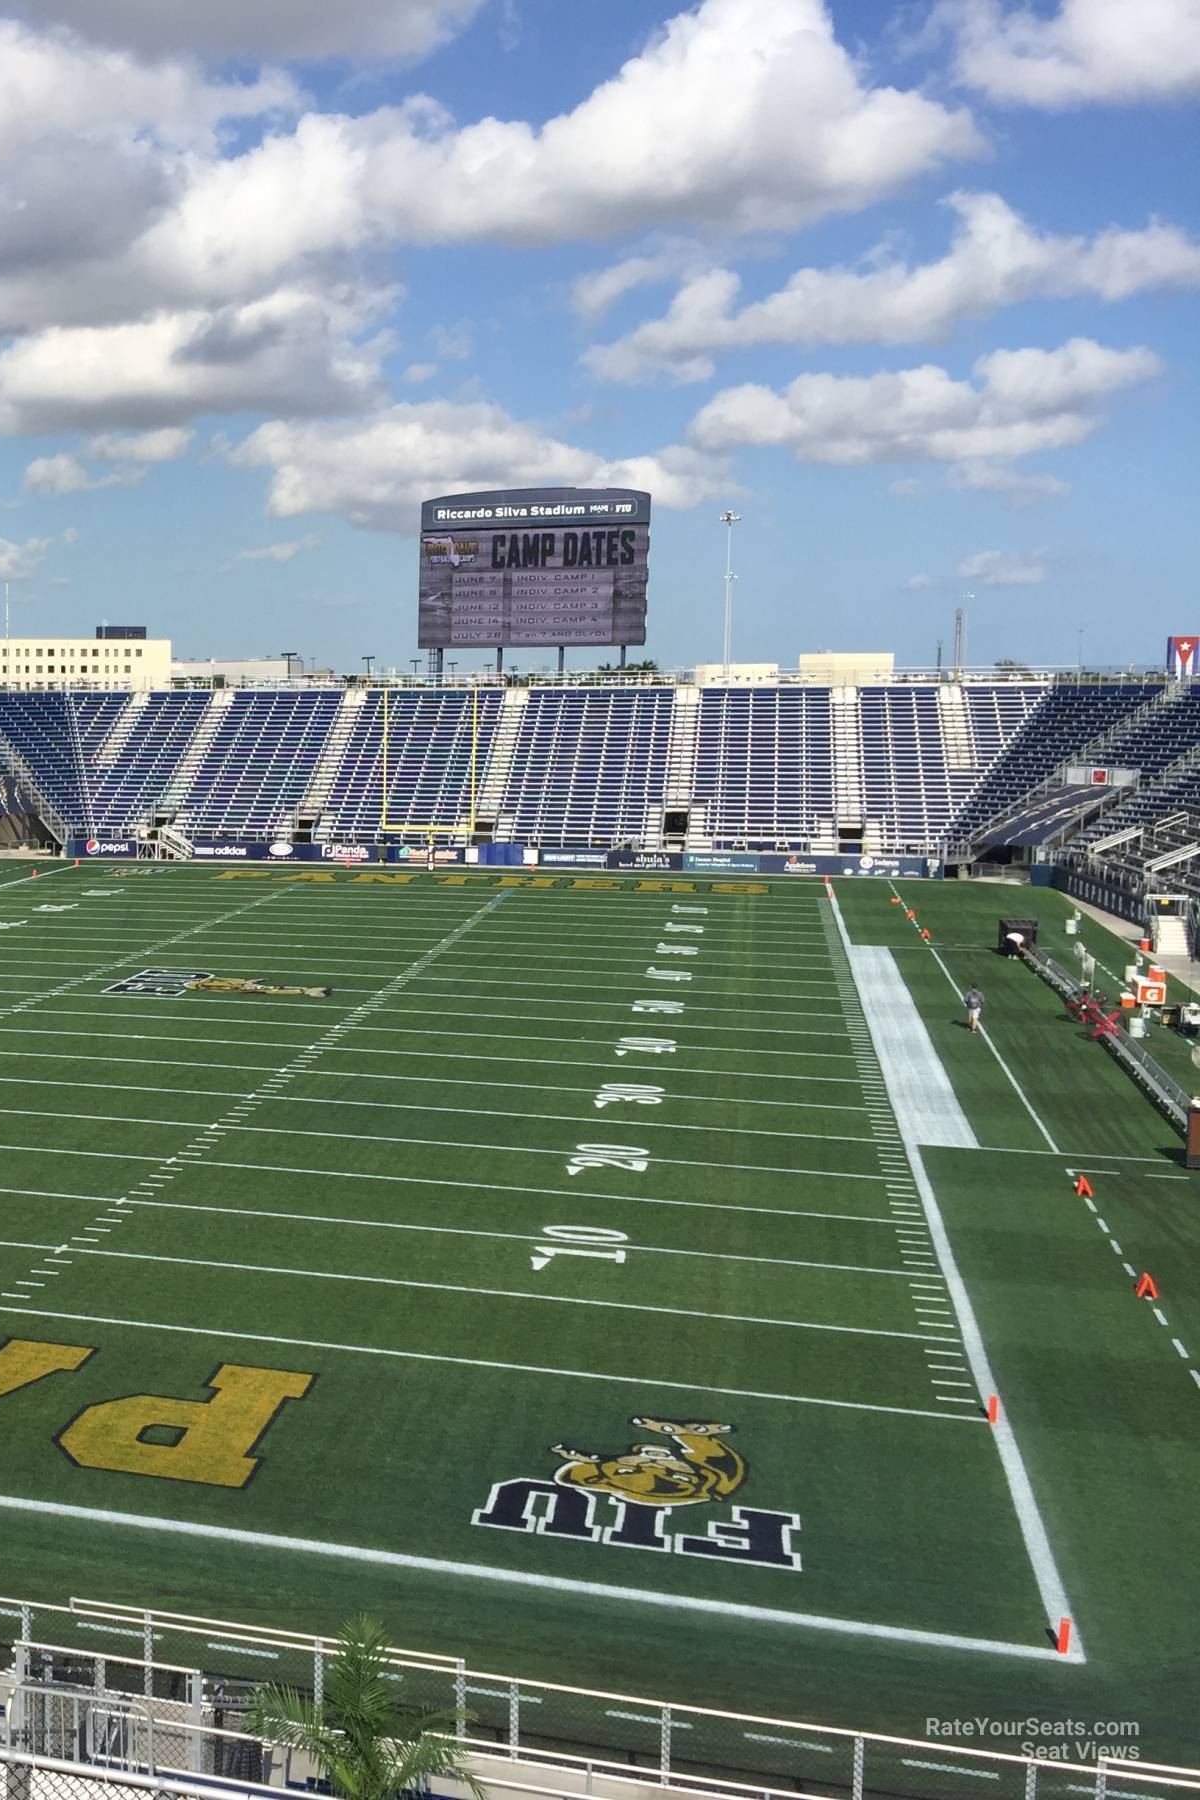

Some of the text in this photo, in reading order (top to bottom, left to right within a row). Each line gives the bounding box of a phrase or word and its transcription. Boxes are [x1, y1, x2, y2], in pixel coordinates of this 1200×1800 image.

[437, 504, 585, 520] Riccardo Silva Stadium
[615, 504, 632, 513] FIU
[491, 530, 636, 569] CAMP DATES
[554, 573, 588, 581] CAMP
[455, 589, 483, 597] JUNE
[553, 587, 588, 595] CAMP
[454, 603, 484, 611] JUNE
[553, 602, 587, 610] CAMP
[100, 842, 129, 854] pepsi
[214, 846, 247, 856] adidas
[335, 844, 366, 855] Panda
[635, 854, 670, 863] shula's
[208, 871, 770, 894] PANTHERS
[1146, 988, 1158, 1001] G
[595, 1083, 666, 1104] 30
[569, 1143, 650, 1172] 20
[534, 1225, 629, 1264] 10
[470, 1477, 802, 1572] FIU
